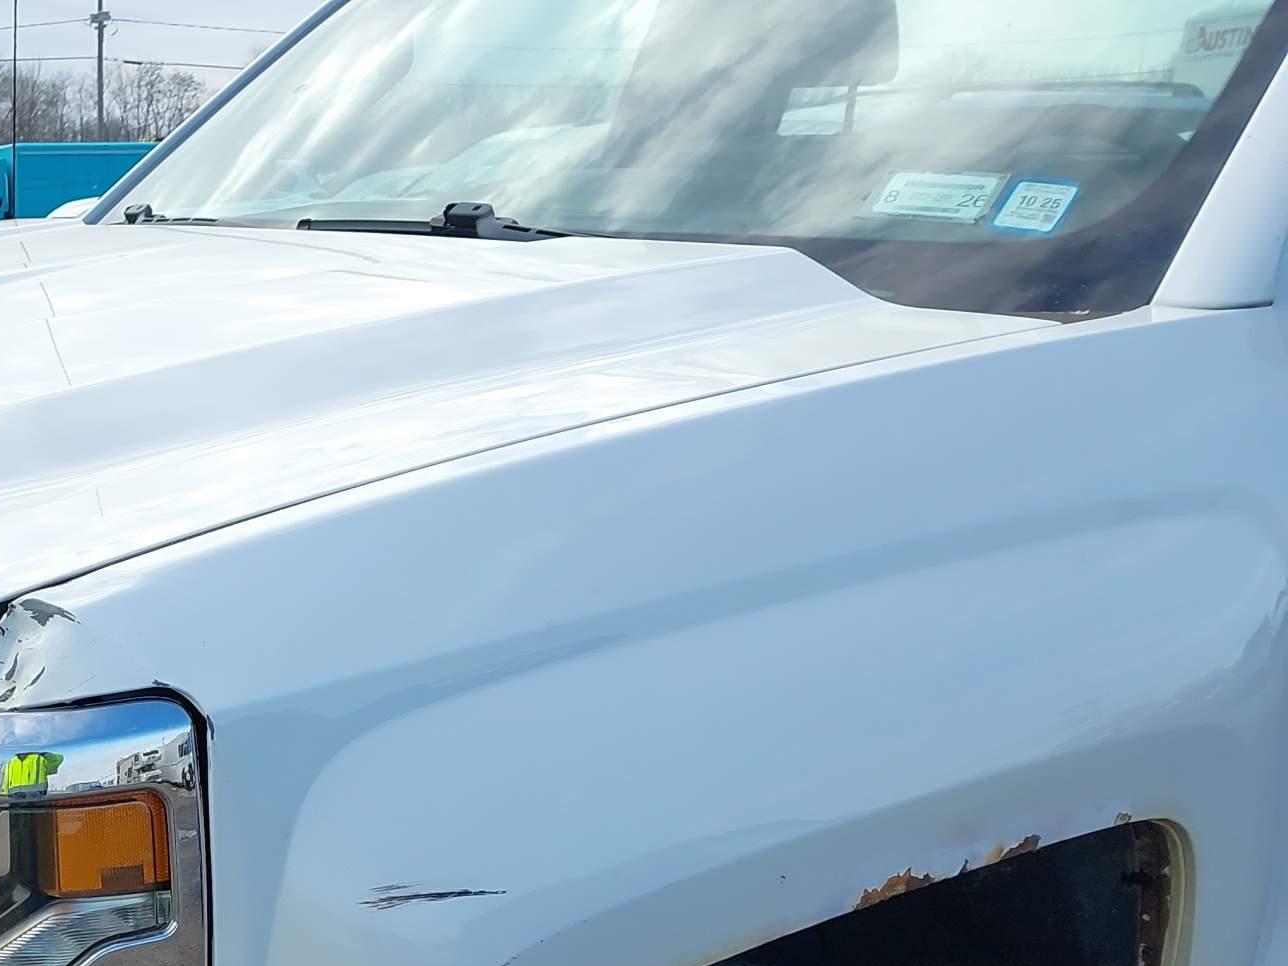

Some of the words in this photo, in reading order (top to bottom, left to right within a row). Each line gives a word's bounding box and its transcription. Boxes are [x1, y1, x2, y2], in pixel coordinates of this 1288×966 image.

[884, 189, 900, 204] 8
[956, 193, 990, 208] 26
[1019, 194, 1038, 207] 10
[1040, 196, 1063, 210] 25
